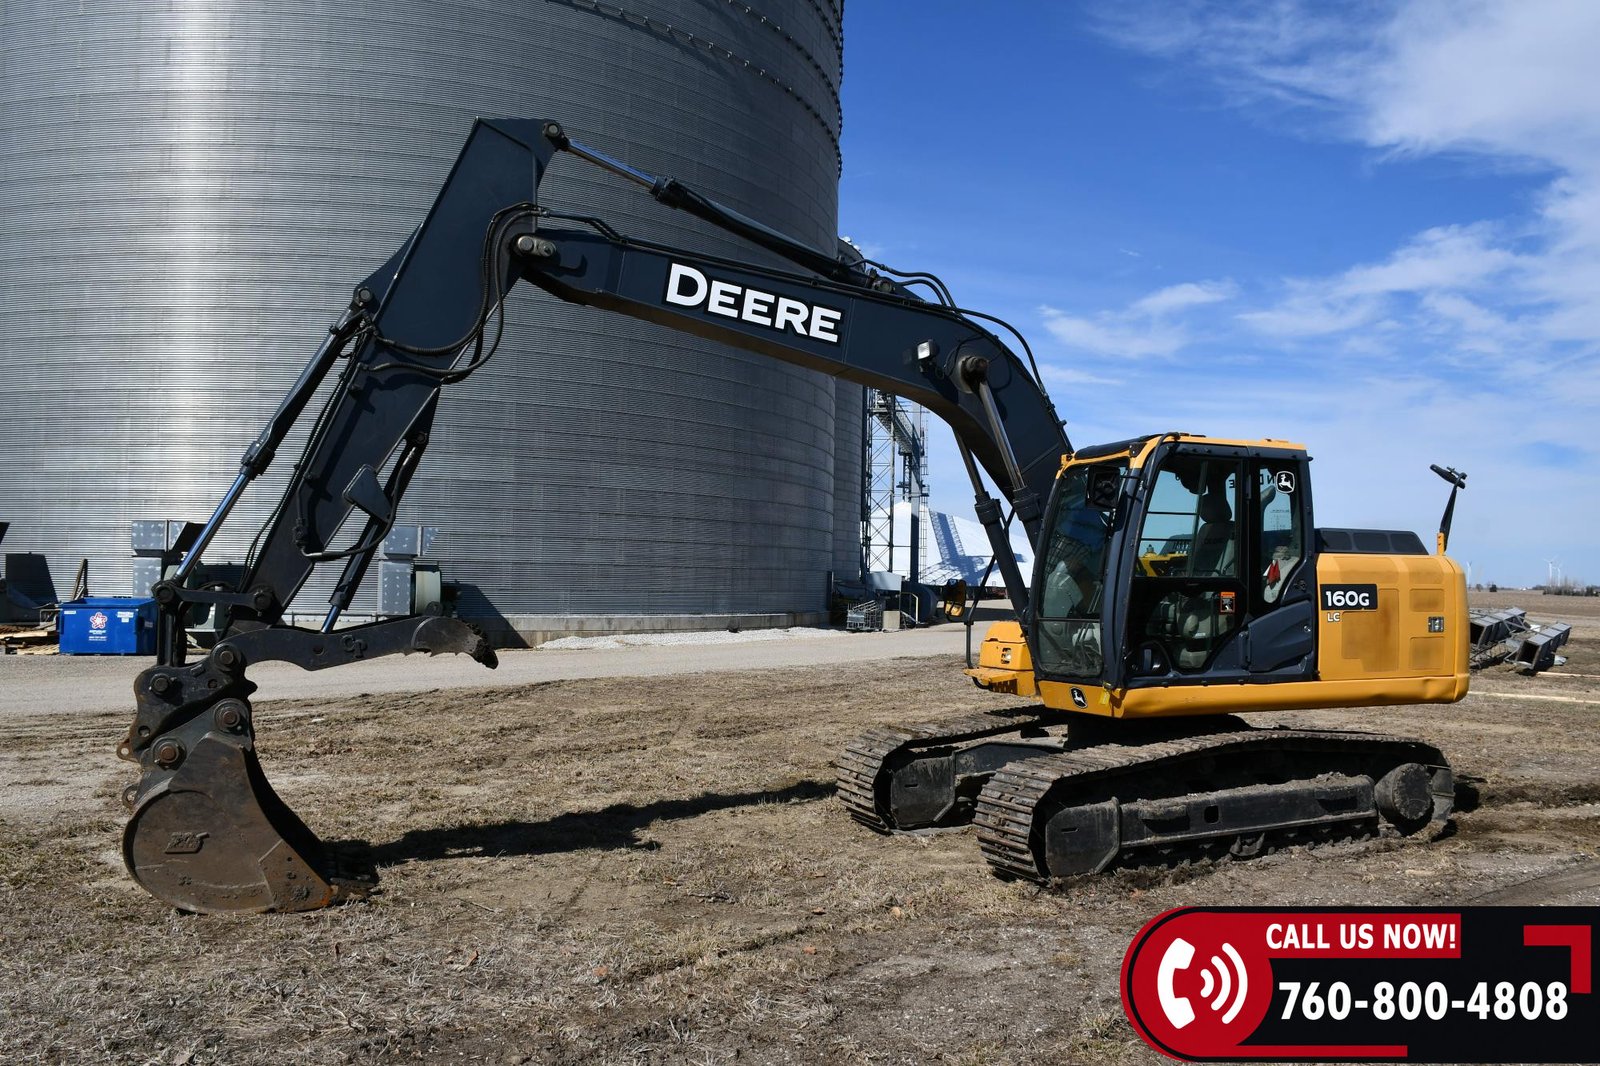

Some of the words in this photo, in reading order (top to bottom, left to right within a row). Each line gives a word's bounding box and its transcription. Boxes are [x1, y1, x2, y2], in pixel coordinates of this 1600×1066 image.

[666, 262, 842, 343] DEERE
[1325, 590, 1370, 607] 160G
[1327, 612, 1341, 622] LC
